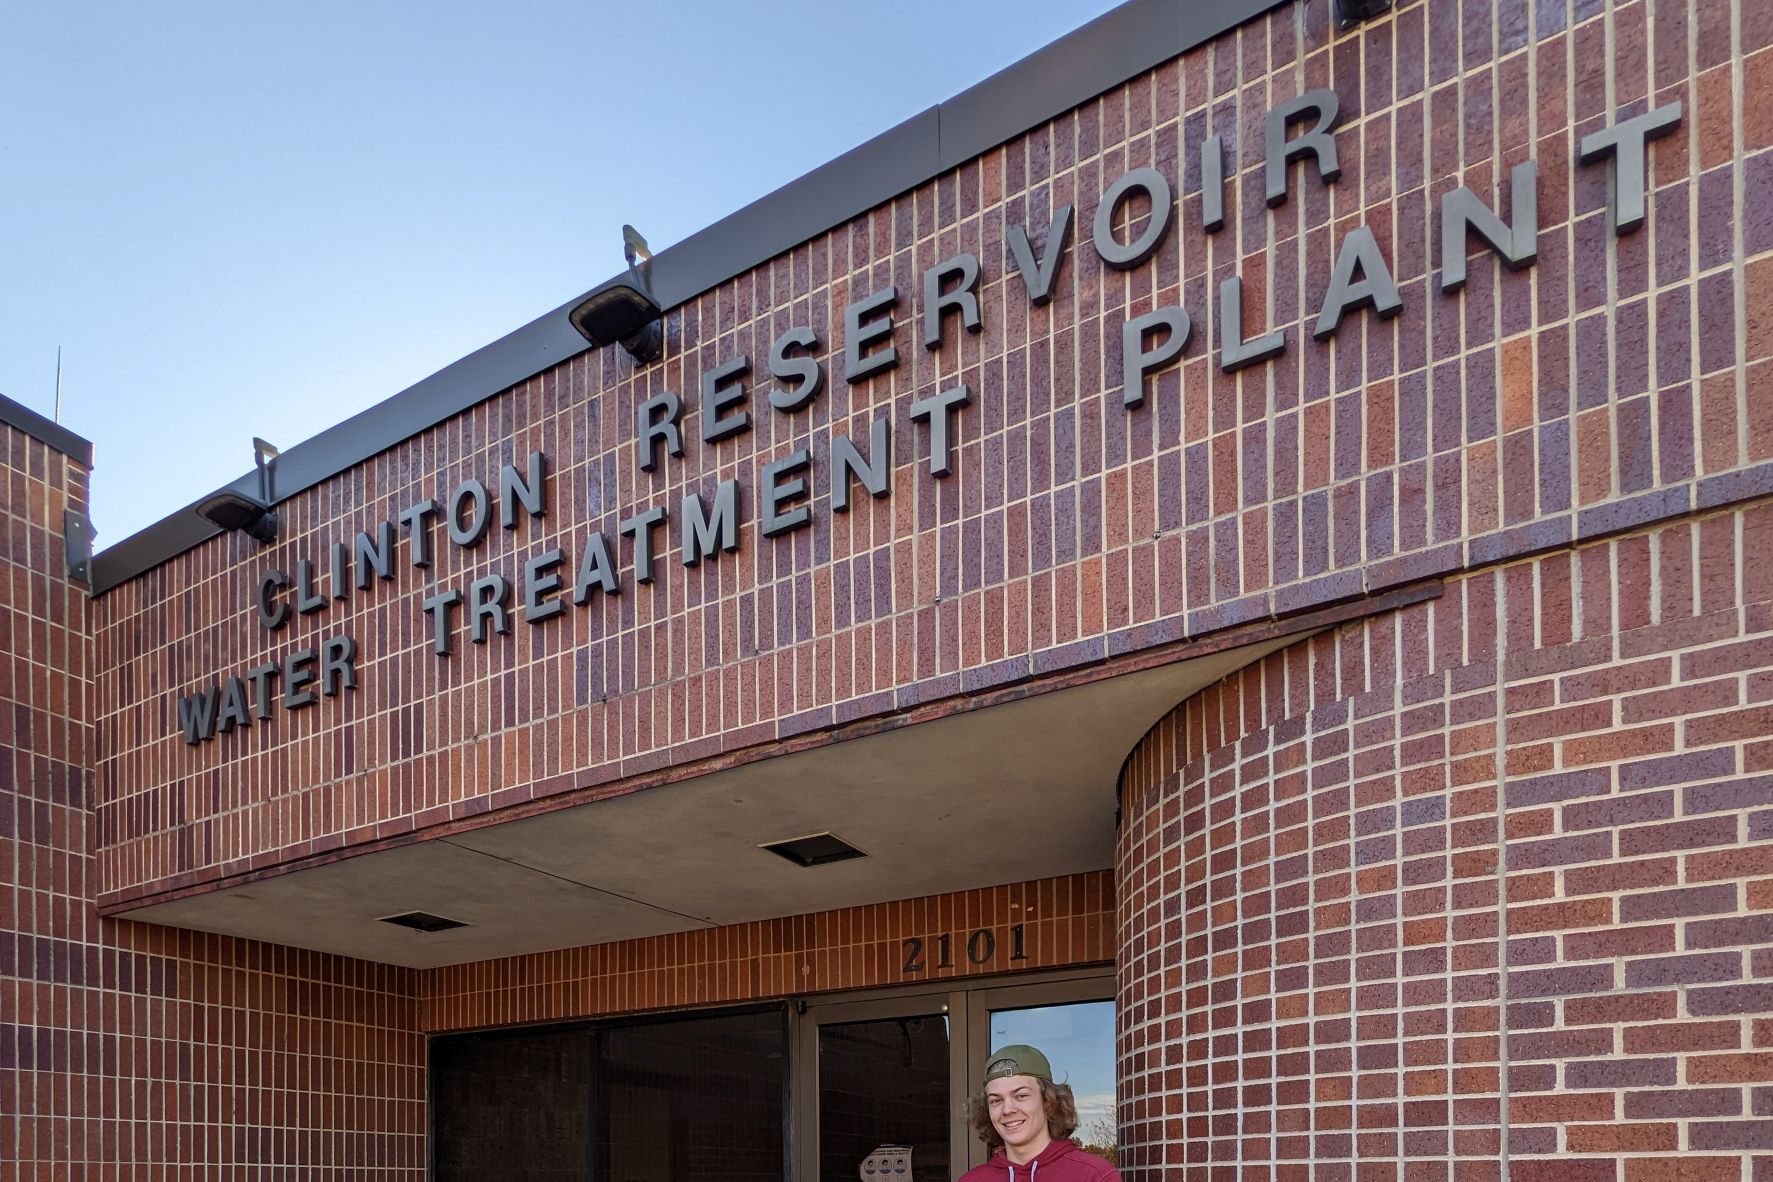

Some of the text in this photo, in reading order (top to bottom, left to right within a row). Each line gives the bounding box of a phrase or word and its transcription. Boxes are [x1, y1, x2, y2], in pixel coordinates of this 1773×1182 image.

[178, 100, 1682, 746] WATER TREATMENT PLANT
[258, 87, 1342, 630] CLINTON RESERVOIR
[902, 922, 1029, 973] 2101
